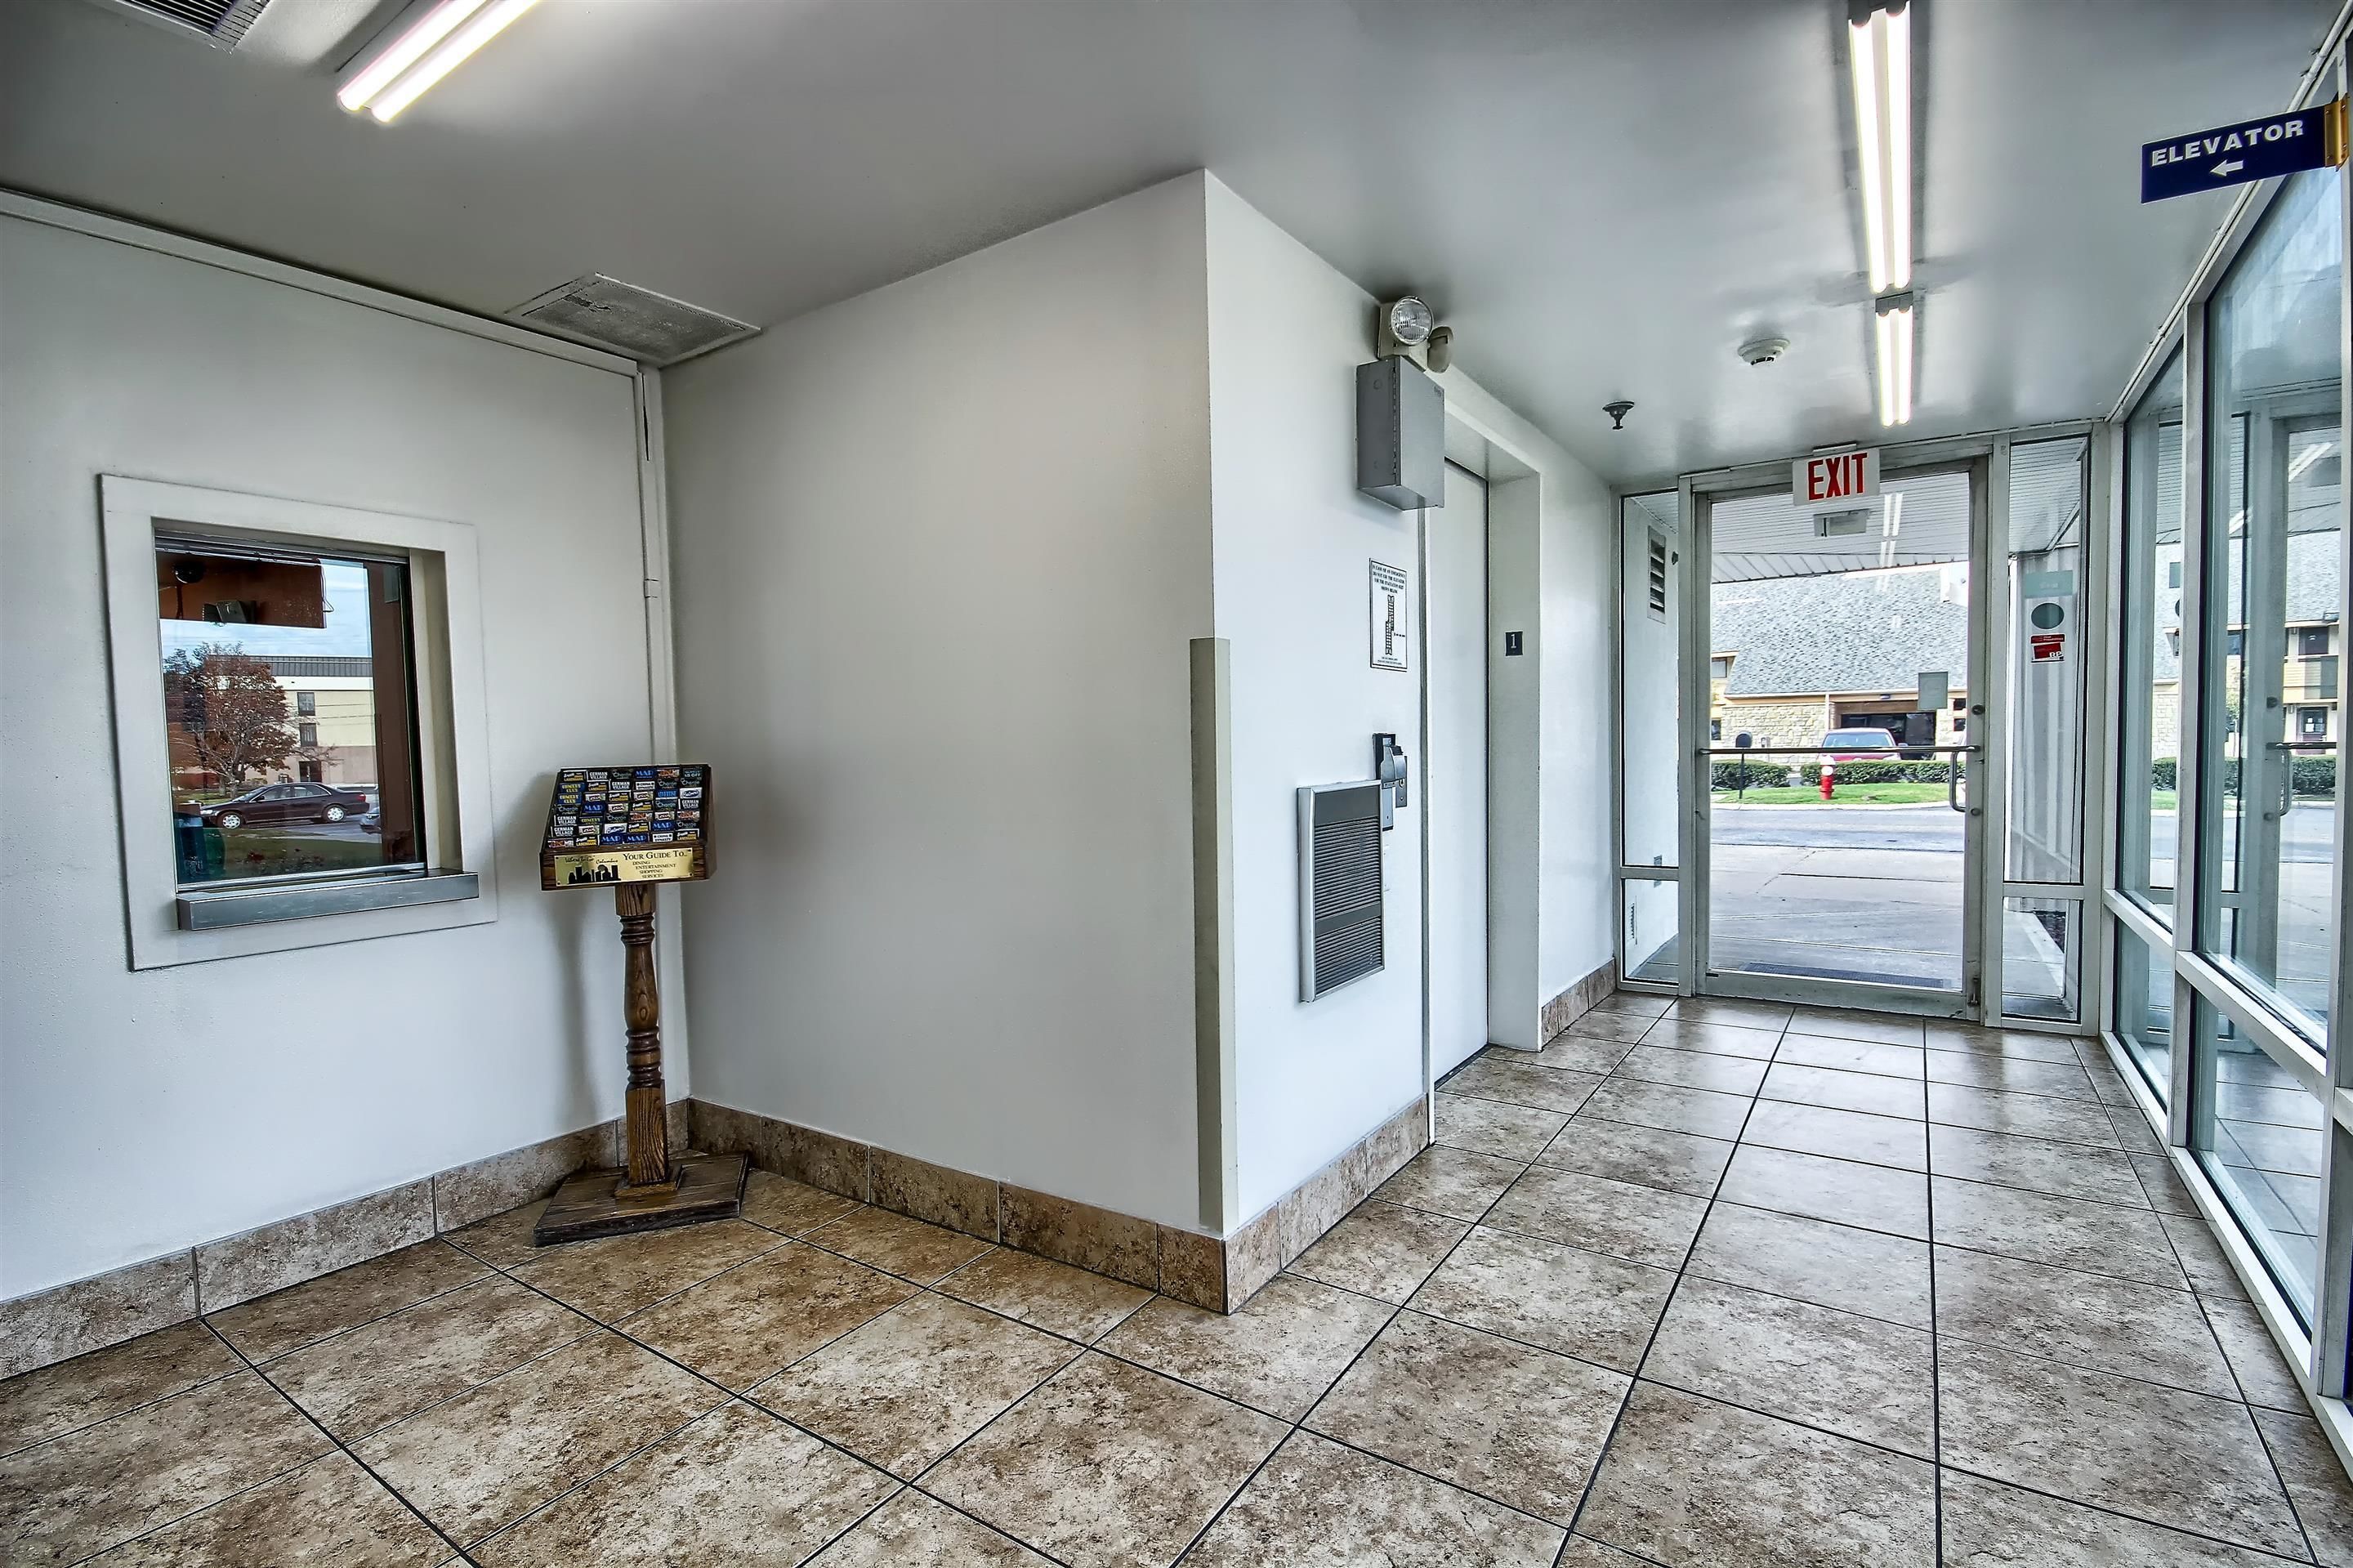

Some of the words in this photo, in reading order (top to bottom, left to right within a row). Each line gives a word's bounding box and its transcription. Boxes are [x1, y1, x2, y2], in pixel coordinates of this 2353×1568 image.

[2151, 119, 2304, 167] ELEVATOR
[1808, 452, 1868, 501] EXIT
[1511, 633, 1517, 649] 1
